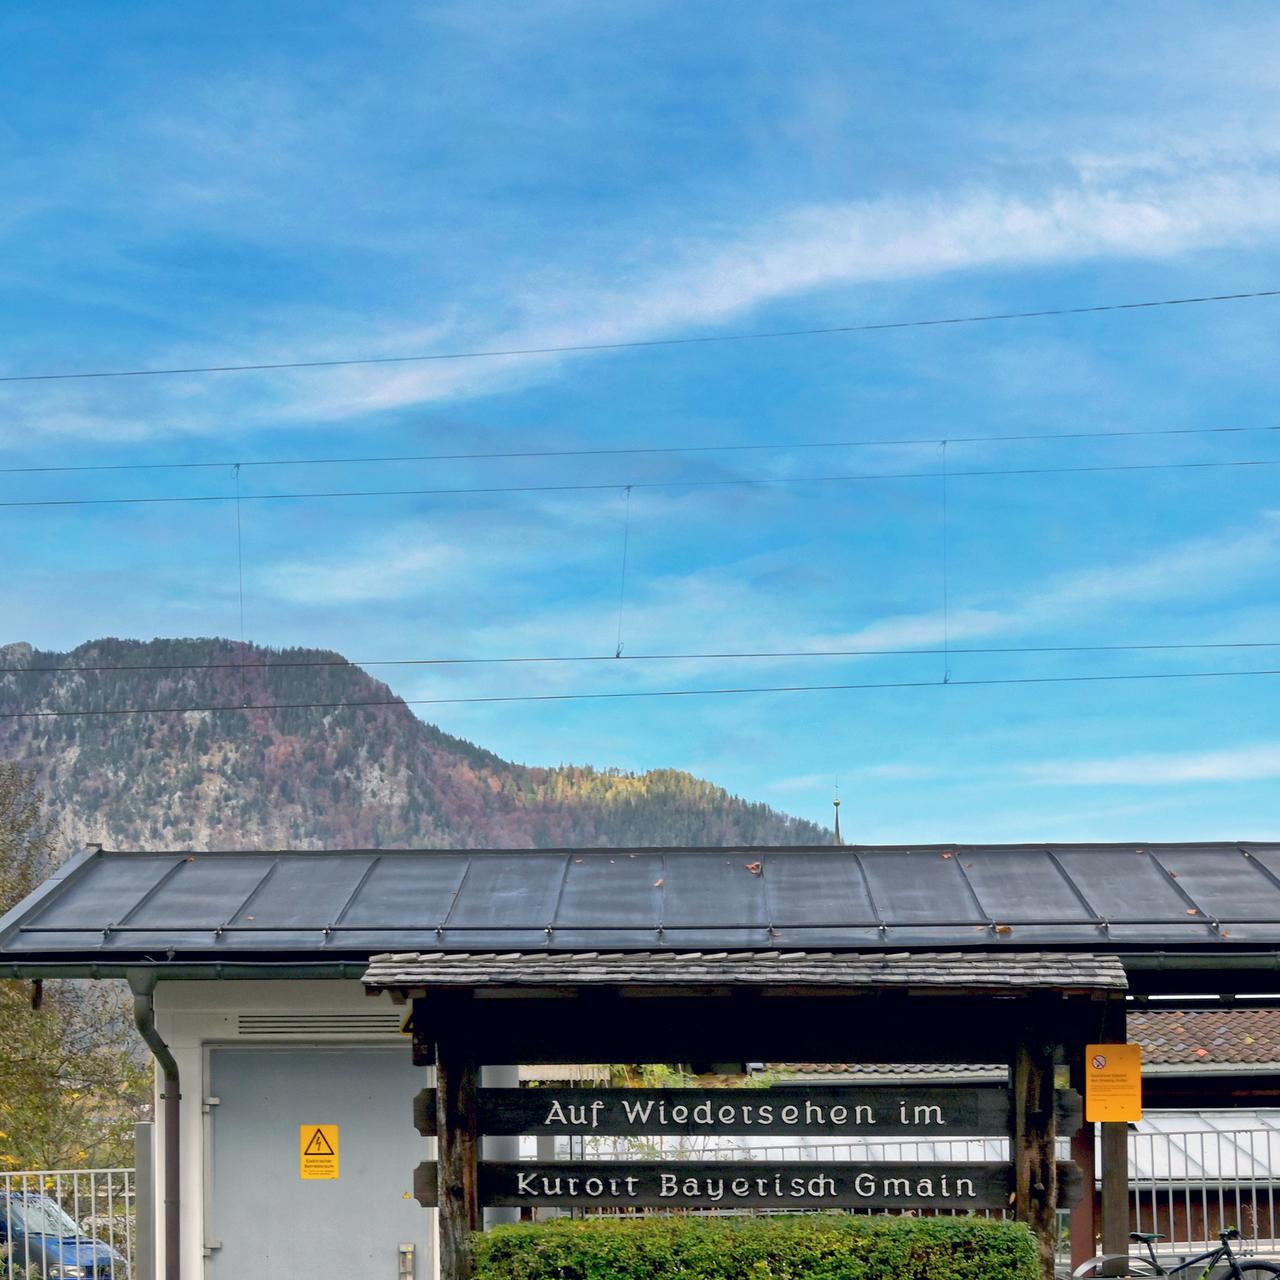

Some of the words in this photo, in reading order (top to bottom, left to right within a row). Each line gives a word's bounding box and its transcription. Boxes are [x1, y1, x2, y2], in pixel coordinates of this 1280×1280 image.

[544, 1100, 605, 1129] Auf
[620, 1100, 877, 1125] Wiedersehen
[900, 1101, 945, 1125] im
[516, 1173, 639, 1197] Kurort
[659, 1173, 838, 1201] Bayerisch
[854, 1173, 978, 1197] Gmain
